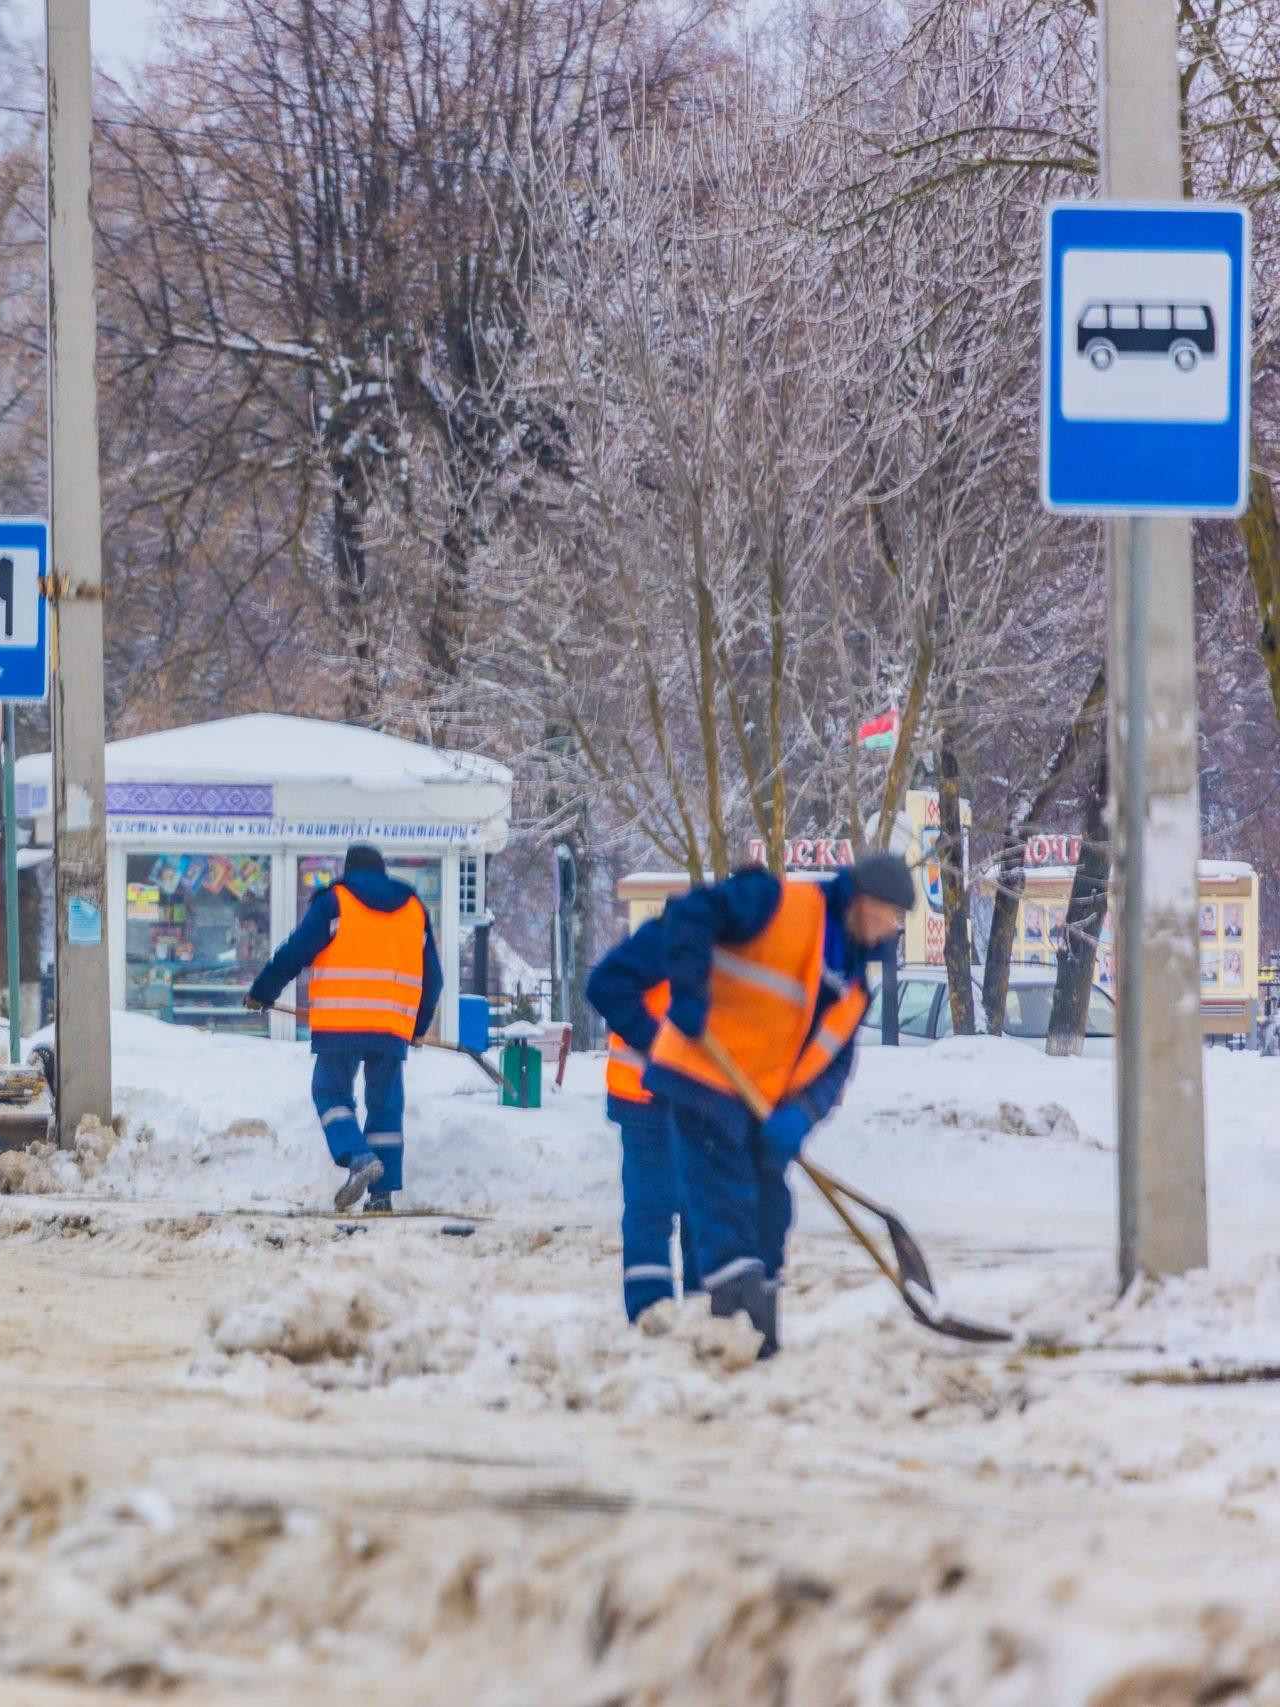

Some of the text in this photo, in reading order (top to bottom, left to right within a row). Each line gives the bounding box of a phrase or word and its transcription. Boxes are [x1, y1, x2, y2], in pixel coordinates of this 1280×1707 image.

[172, 820, 235, 834] часопісы
[297, 818, 372, 838] паштоўкі
[383, 823, 468, 841] канцтавары
